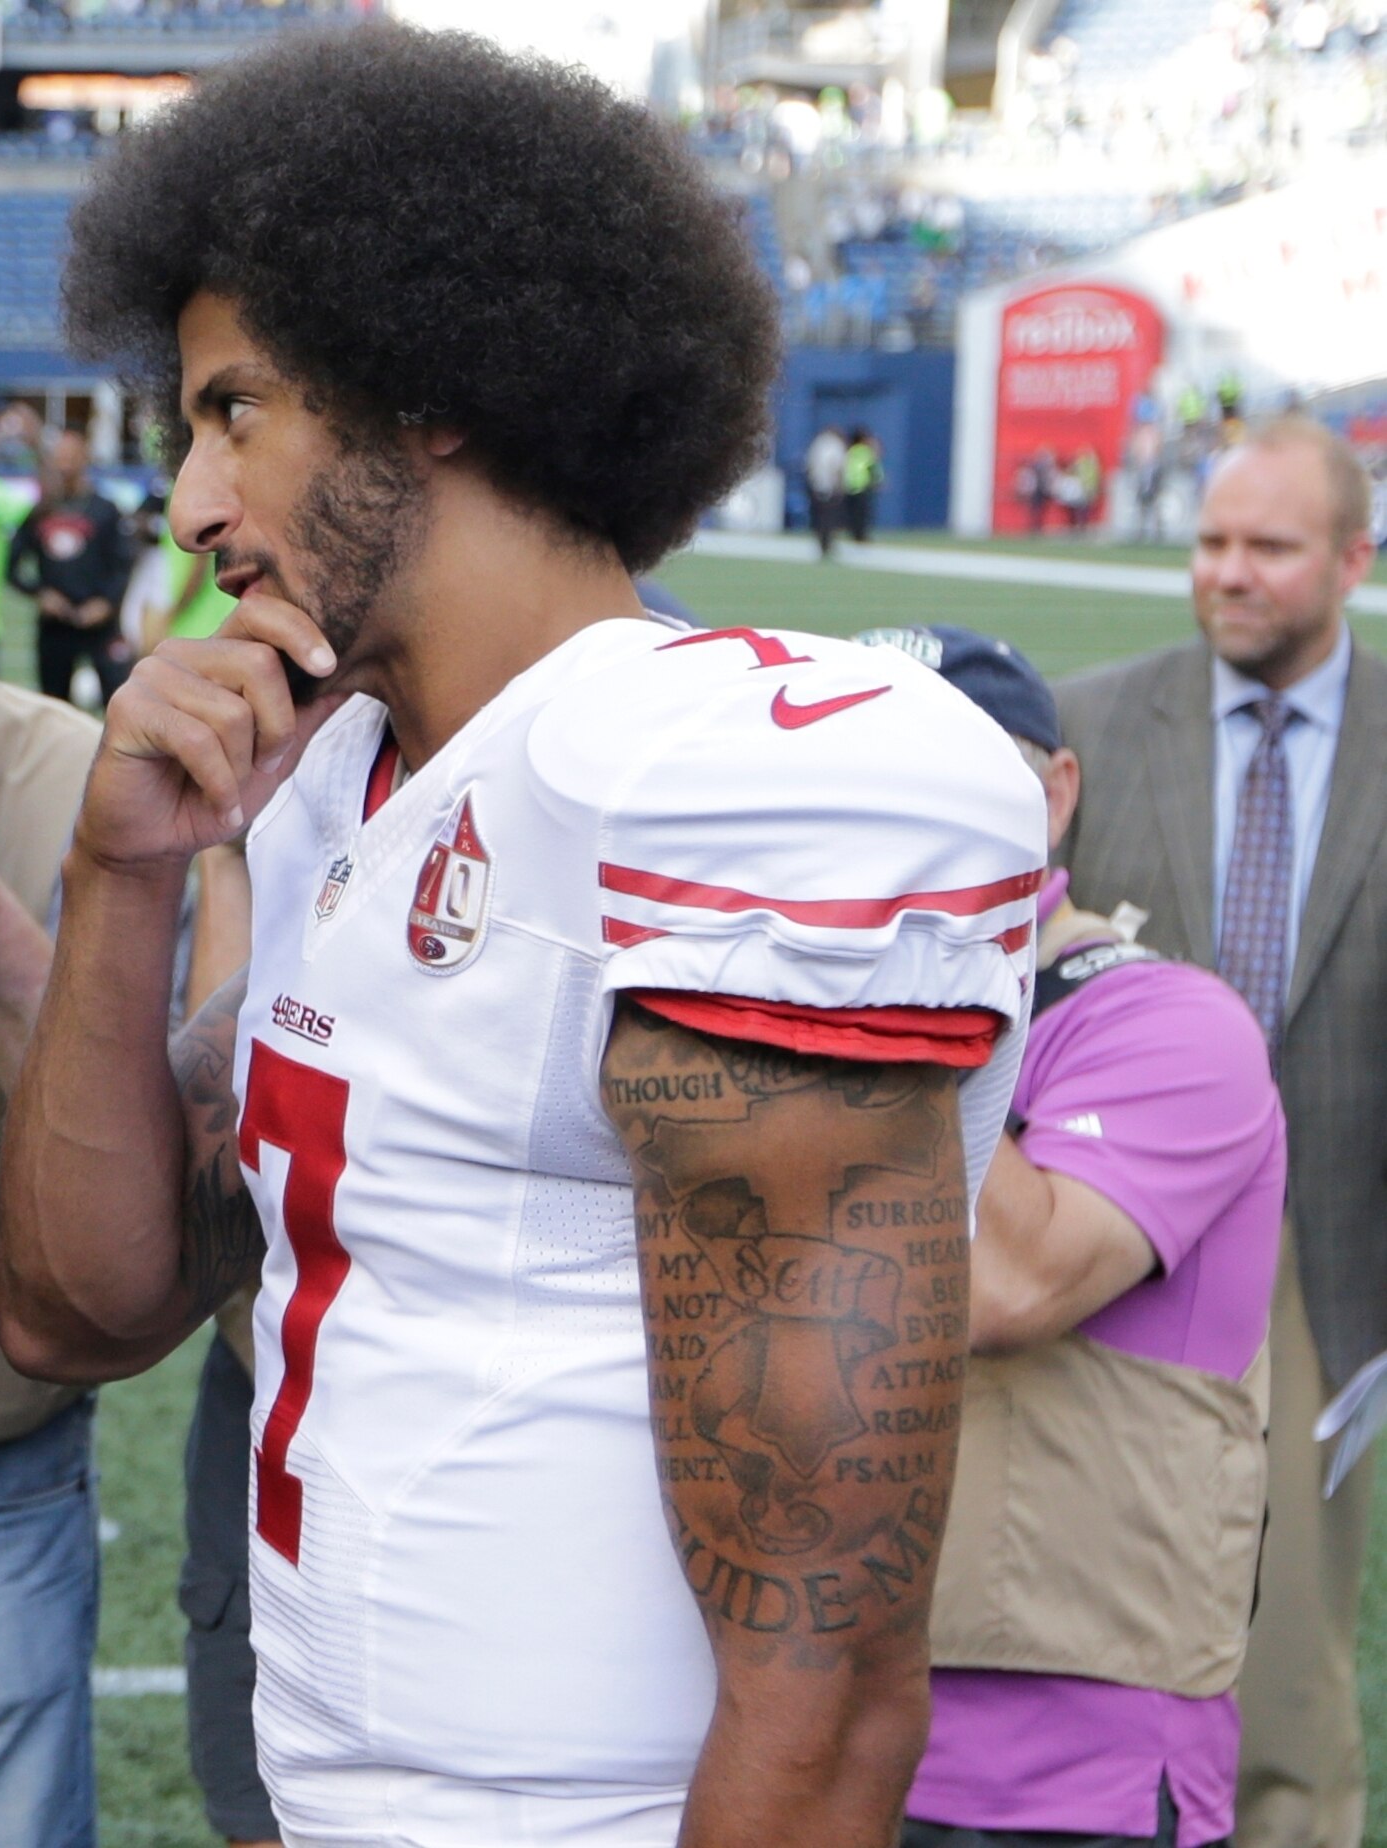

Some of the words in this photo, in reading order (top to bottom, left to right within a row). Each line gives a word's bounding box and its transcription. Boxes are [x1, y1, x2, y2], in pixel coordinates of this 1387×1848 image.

[316, 882, 341, 914] NFL
[271, 993, 335, 1041] 49ERS
[611, 1071, 724, 1104] THOUGH
[657, 1253, 707, 1281] MY
[238, 1038, 351, 1569] 7
[664, 1292, 724, 1320] NOT
[836, 1452, 936, 1484] PSALM
